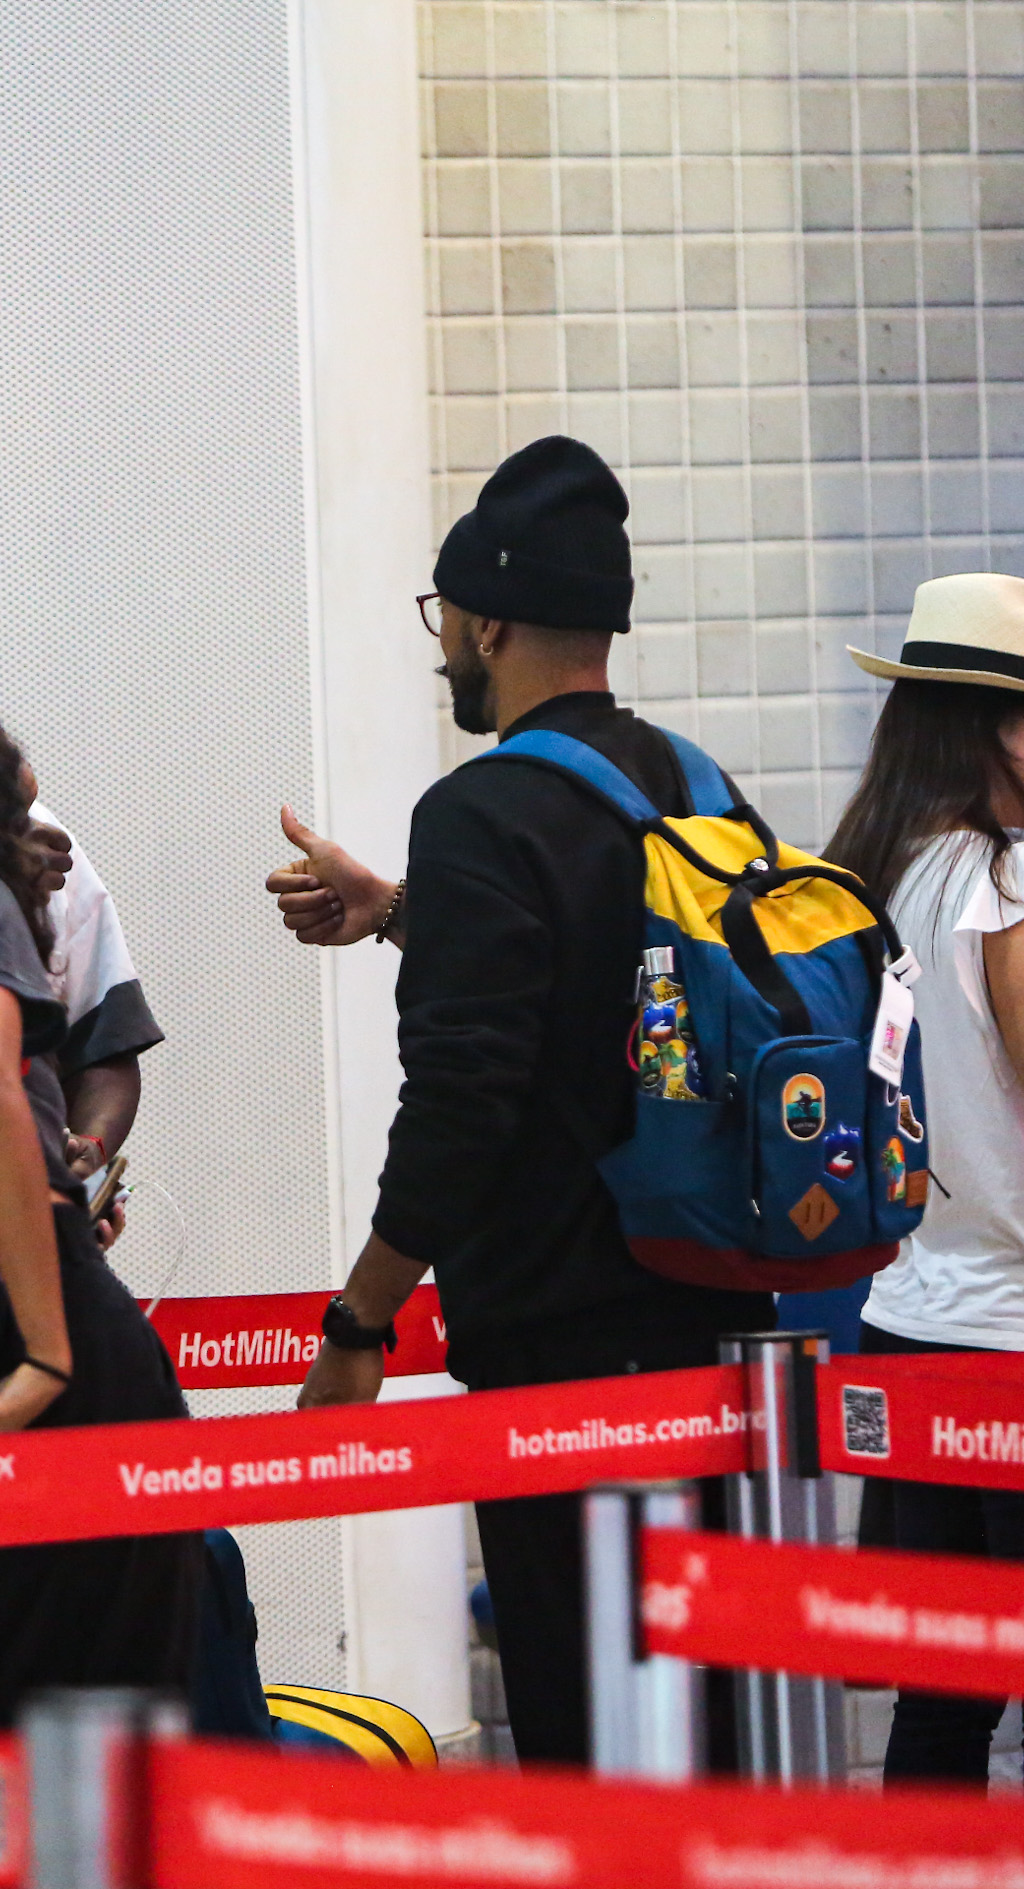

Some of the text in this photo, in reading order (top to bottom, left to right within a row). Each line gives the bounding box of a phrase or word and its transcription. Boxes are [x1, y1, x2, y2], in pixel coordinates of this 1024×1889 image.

[177, 1328, 326, 1367] HotMilha
[119, 1442, 412, 1496] Venda suas milhas
